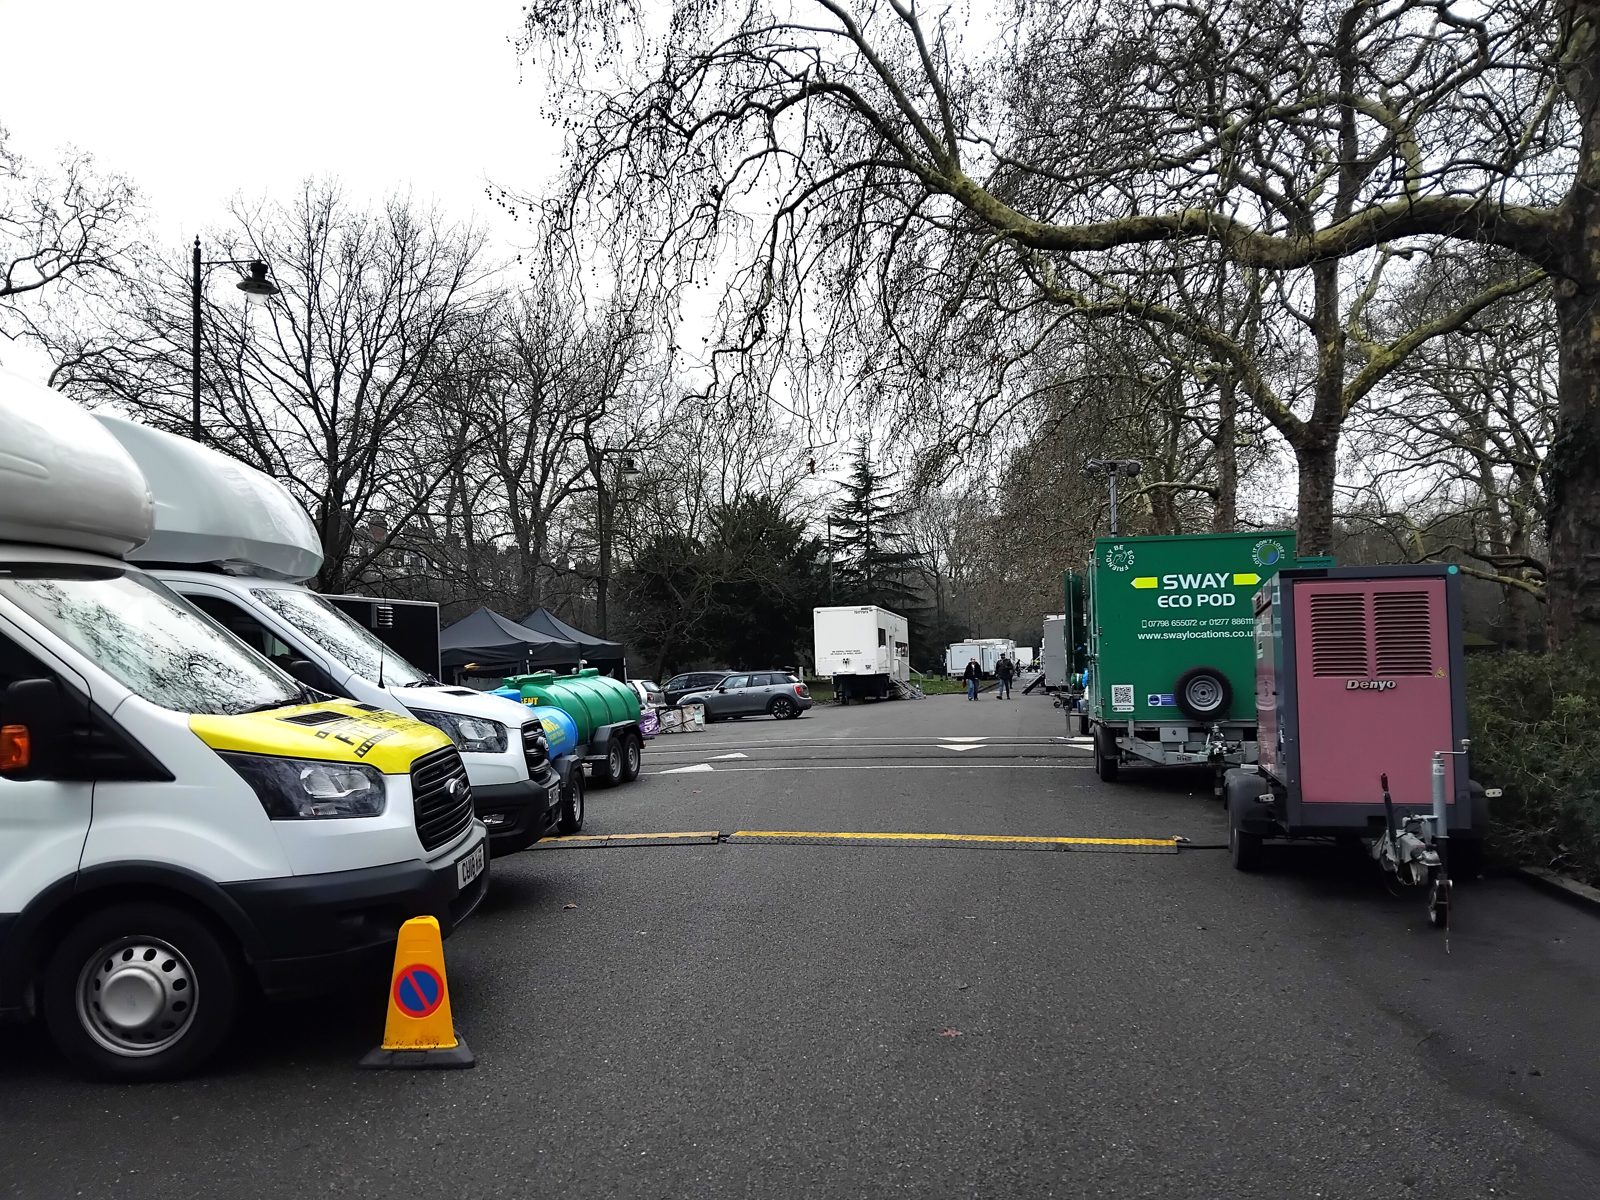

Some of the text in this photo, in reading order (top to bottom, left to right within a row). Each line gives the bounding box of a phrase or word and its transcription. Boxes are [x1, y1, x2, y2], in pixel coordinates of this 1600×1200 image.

[1105, 548, 1129, 572] FRIENDLY
[1127, 550, 1135, 565] ECO
[1252, 554, 1262, 567] LOVE
[1272, 540, 1285, 552] LOSE
[1162, 572, 1230, 590] SWAY
[1157, 593, 1236, 608] ECO POD
[1148, 620, 1170, 628] 07798
[1171, 619, 1197, 627] 655072
[1209, 618, 1229, 626] 01277
[1137, 629, 1253, 641] www.swaylocations.co.u
[1346, 679, 1397, 691] Denyo
